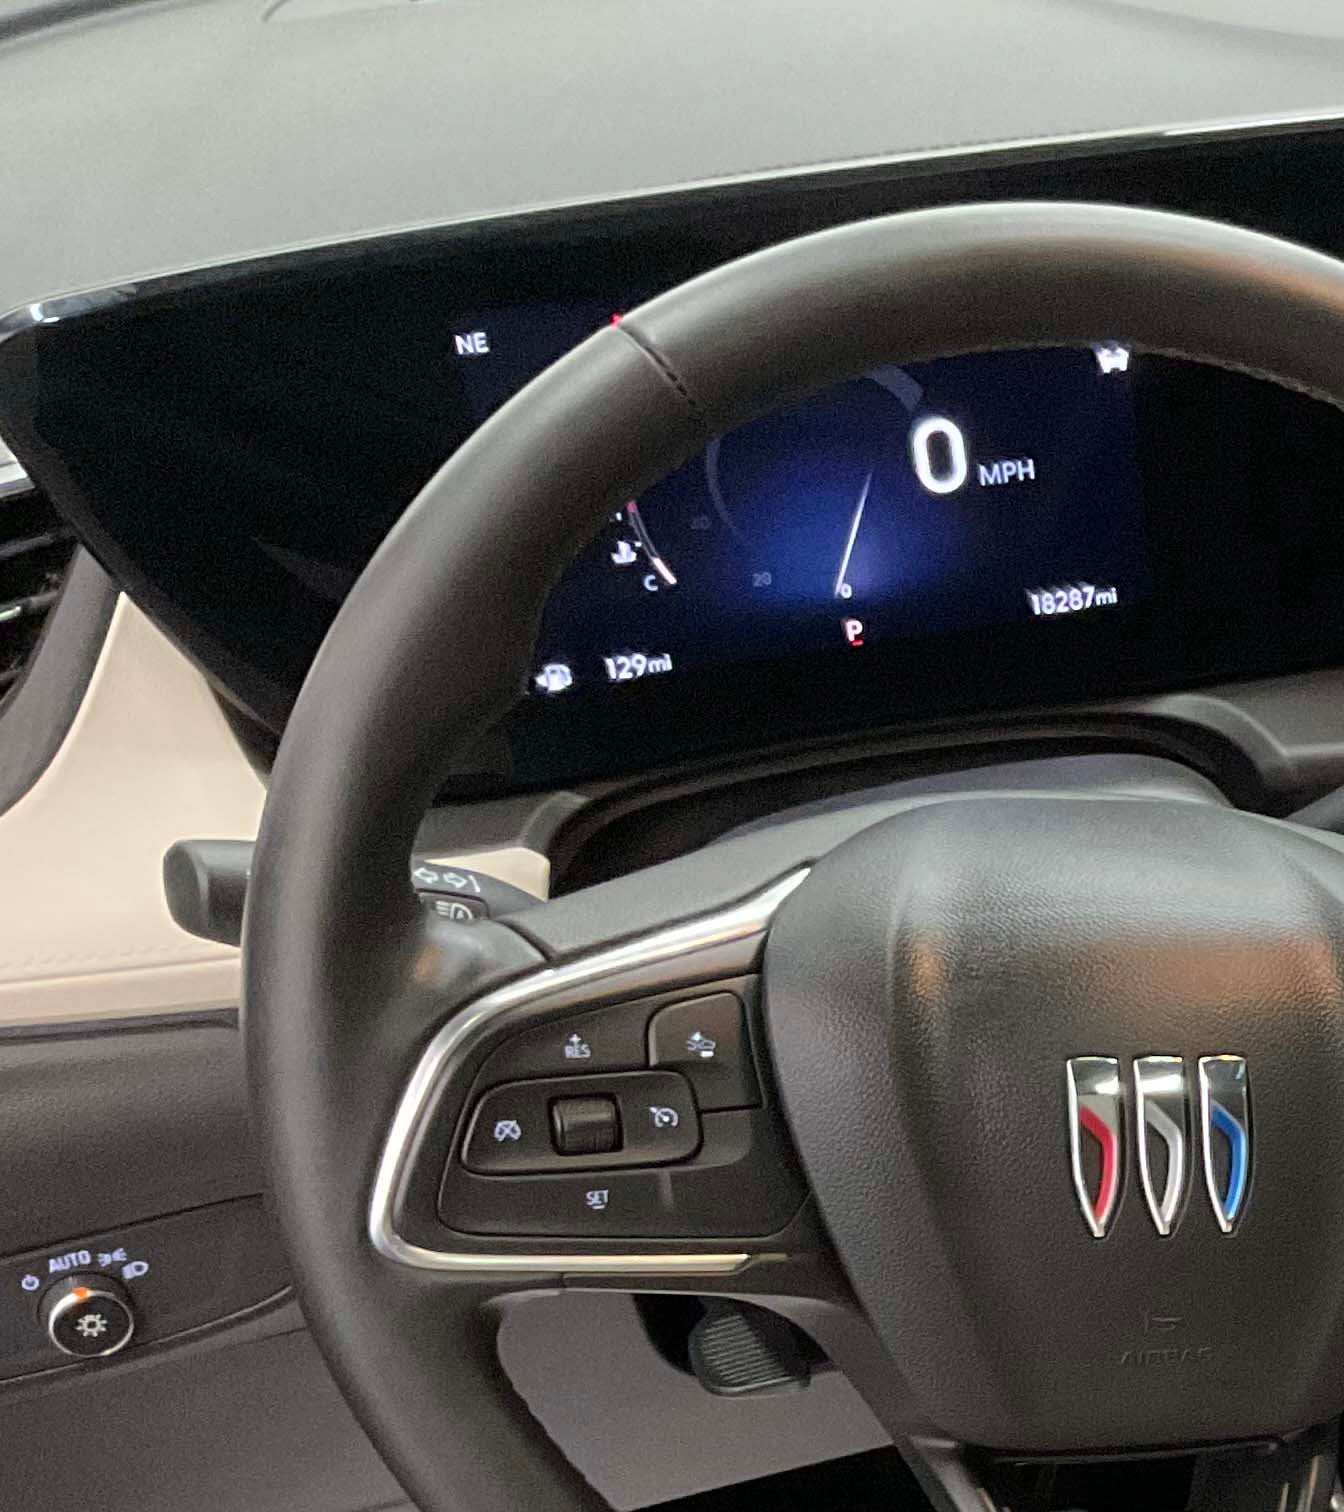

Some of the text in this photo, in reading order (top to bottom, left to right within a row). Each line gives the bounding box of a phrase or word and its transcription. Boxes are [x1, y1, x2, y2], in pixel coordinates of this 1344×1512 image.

[454, 331, 490, 355] NE
[912, 416, 1036, 494] 0 MPH
[845, 618, 864, 643] P
[564, 1043, 592, 1059] RES
[585, 1189, 609, 1206] SET
[49, 1250, 92, 1274] AUTO
